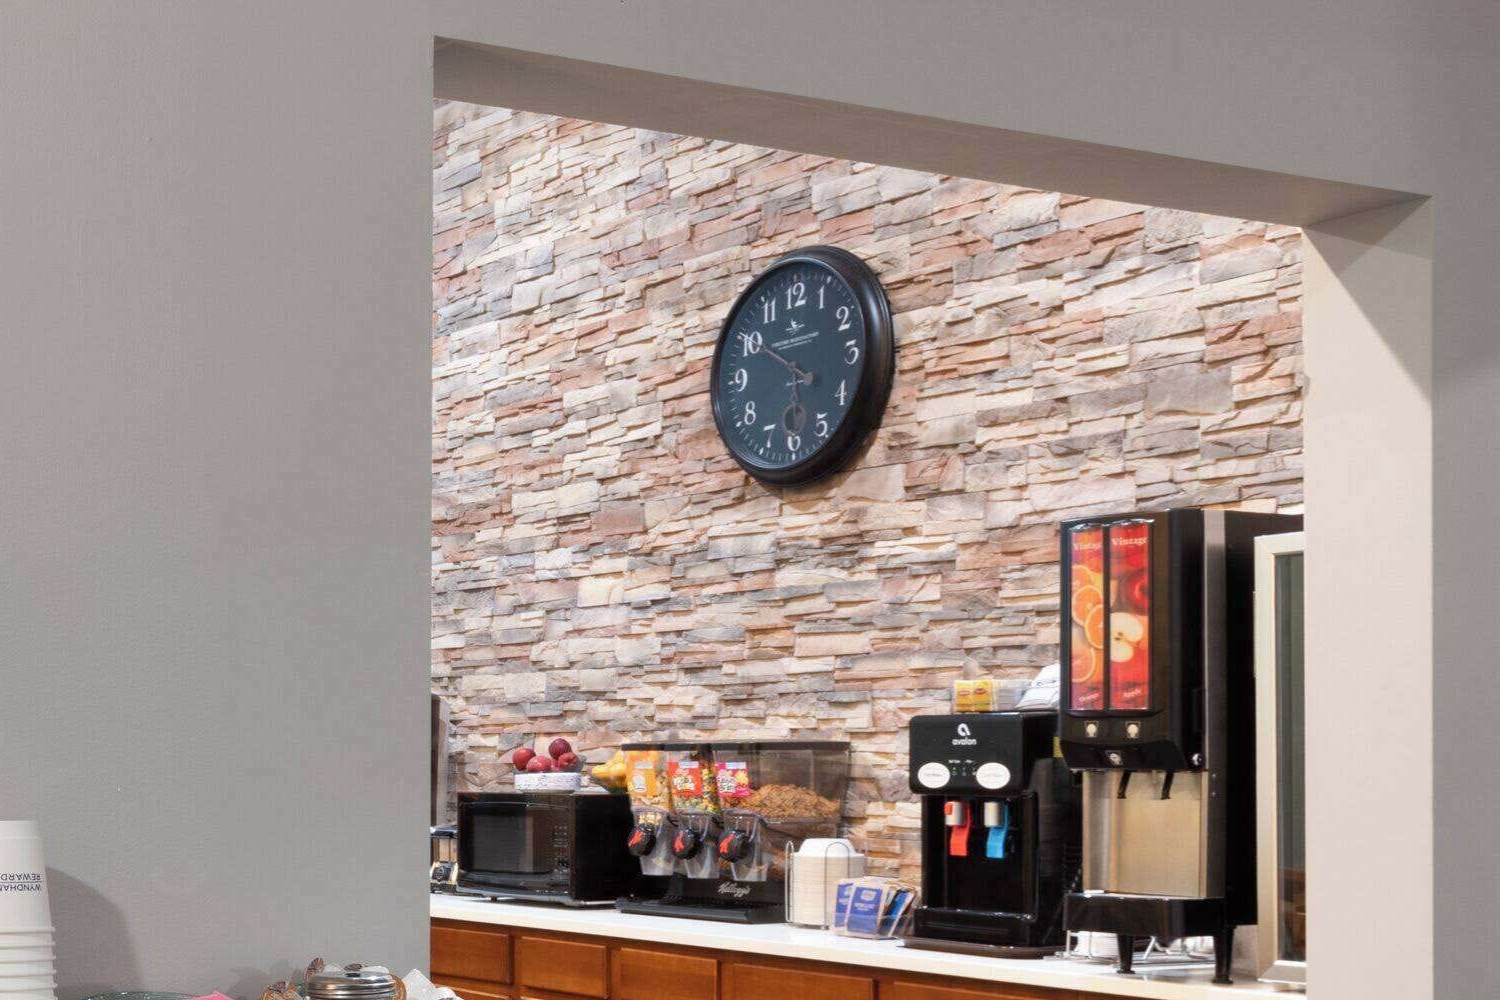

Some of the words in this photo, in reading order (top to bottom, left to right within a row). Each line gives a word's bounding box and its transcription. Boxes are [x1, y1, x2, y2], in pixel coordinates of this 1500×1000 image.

[785, 282, 807, 310] 12
[818, 285, 826, 309] 1
[763, 298, 777, 324] 11
[836, 306, 851, 331] 2
[742, 331, 763, 357] 10
[844, 339, 859, 365] 3
[735, 368, 748, 392] 9
[835, 379, 848, 406] 4
[744, 401, 756, 425] 8
[813, 412, 828, 437] 5
[763, 424, 776, 448] 7
[951, 737, 977, 746] avalon
